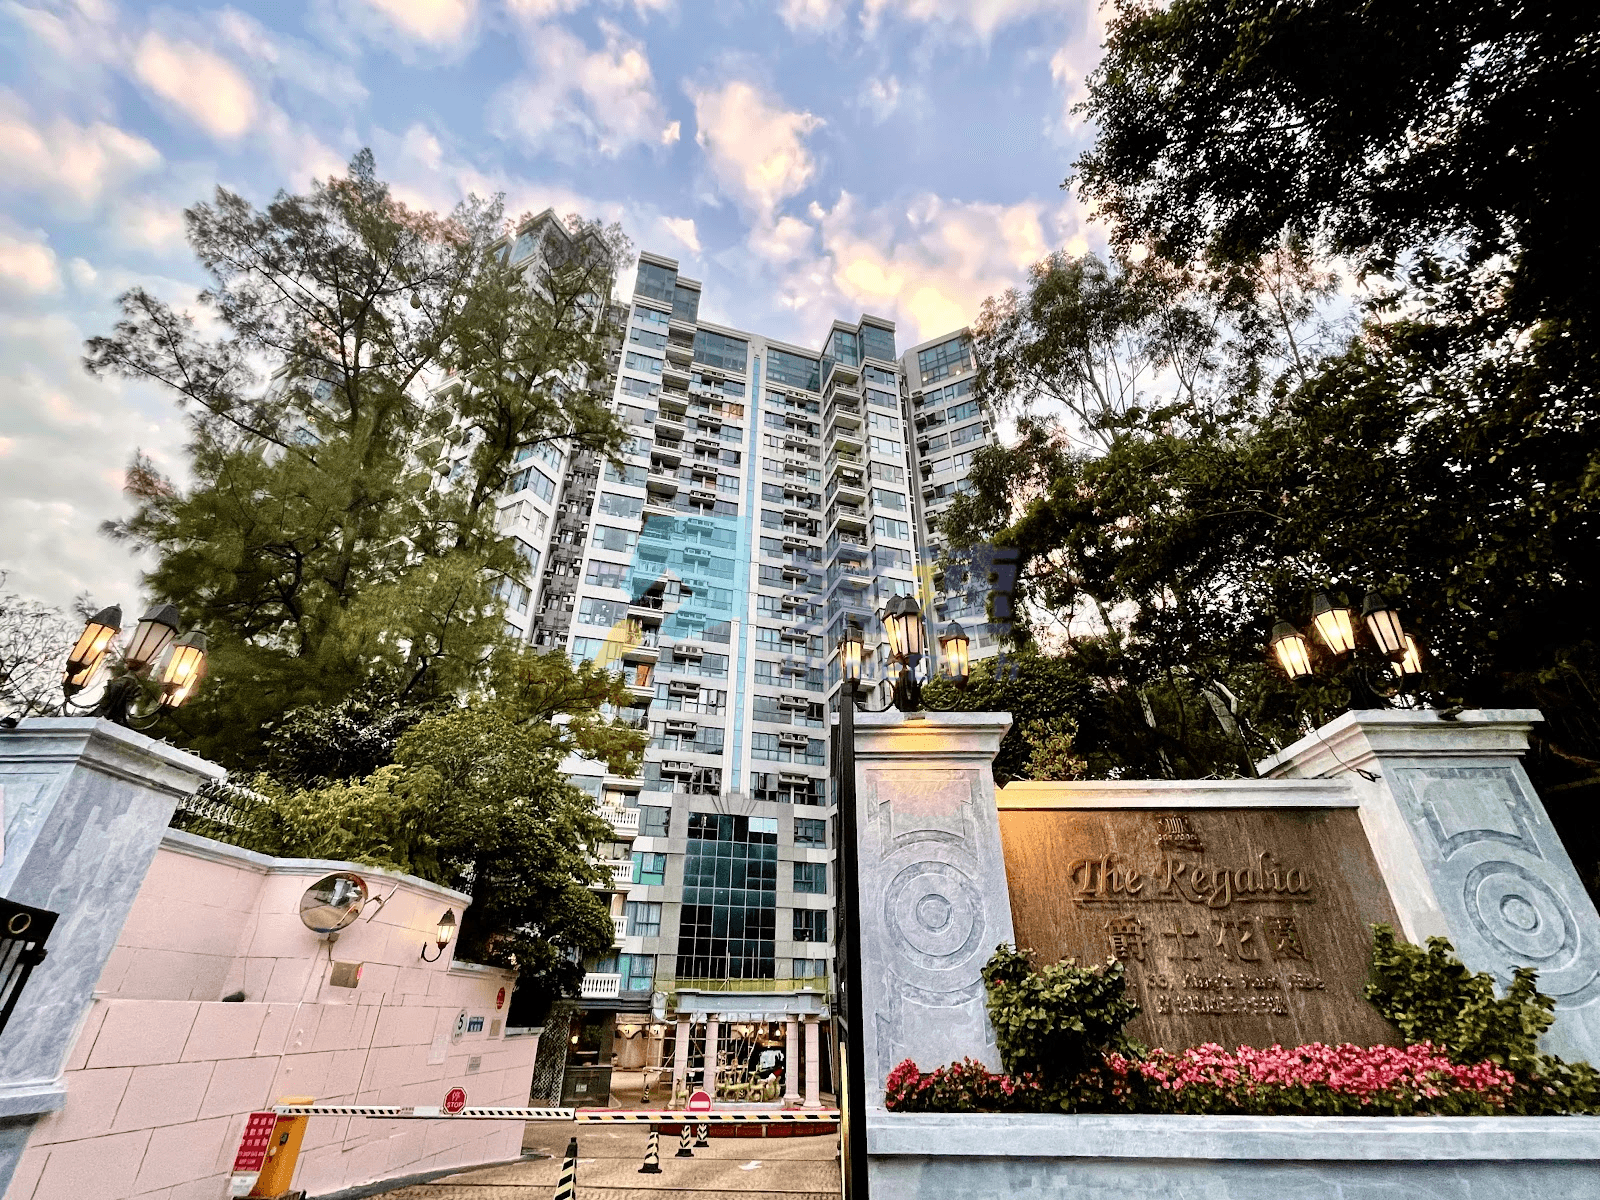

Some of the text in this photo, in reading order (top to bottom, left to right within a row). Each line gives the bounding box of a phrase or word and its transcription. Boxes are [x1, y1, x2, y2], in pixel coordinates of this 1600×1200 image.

[1067, 852, 1313, 908] The Regalia
[458, 1014, 465, 1030] 5
